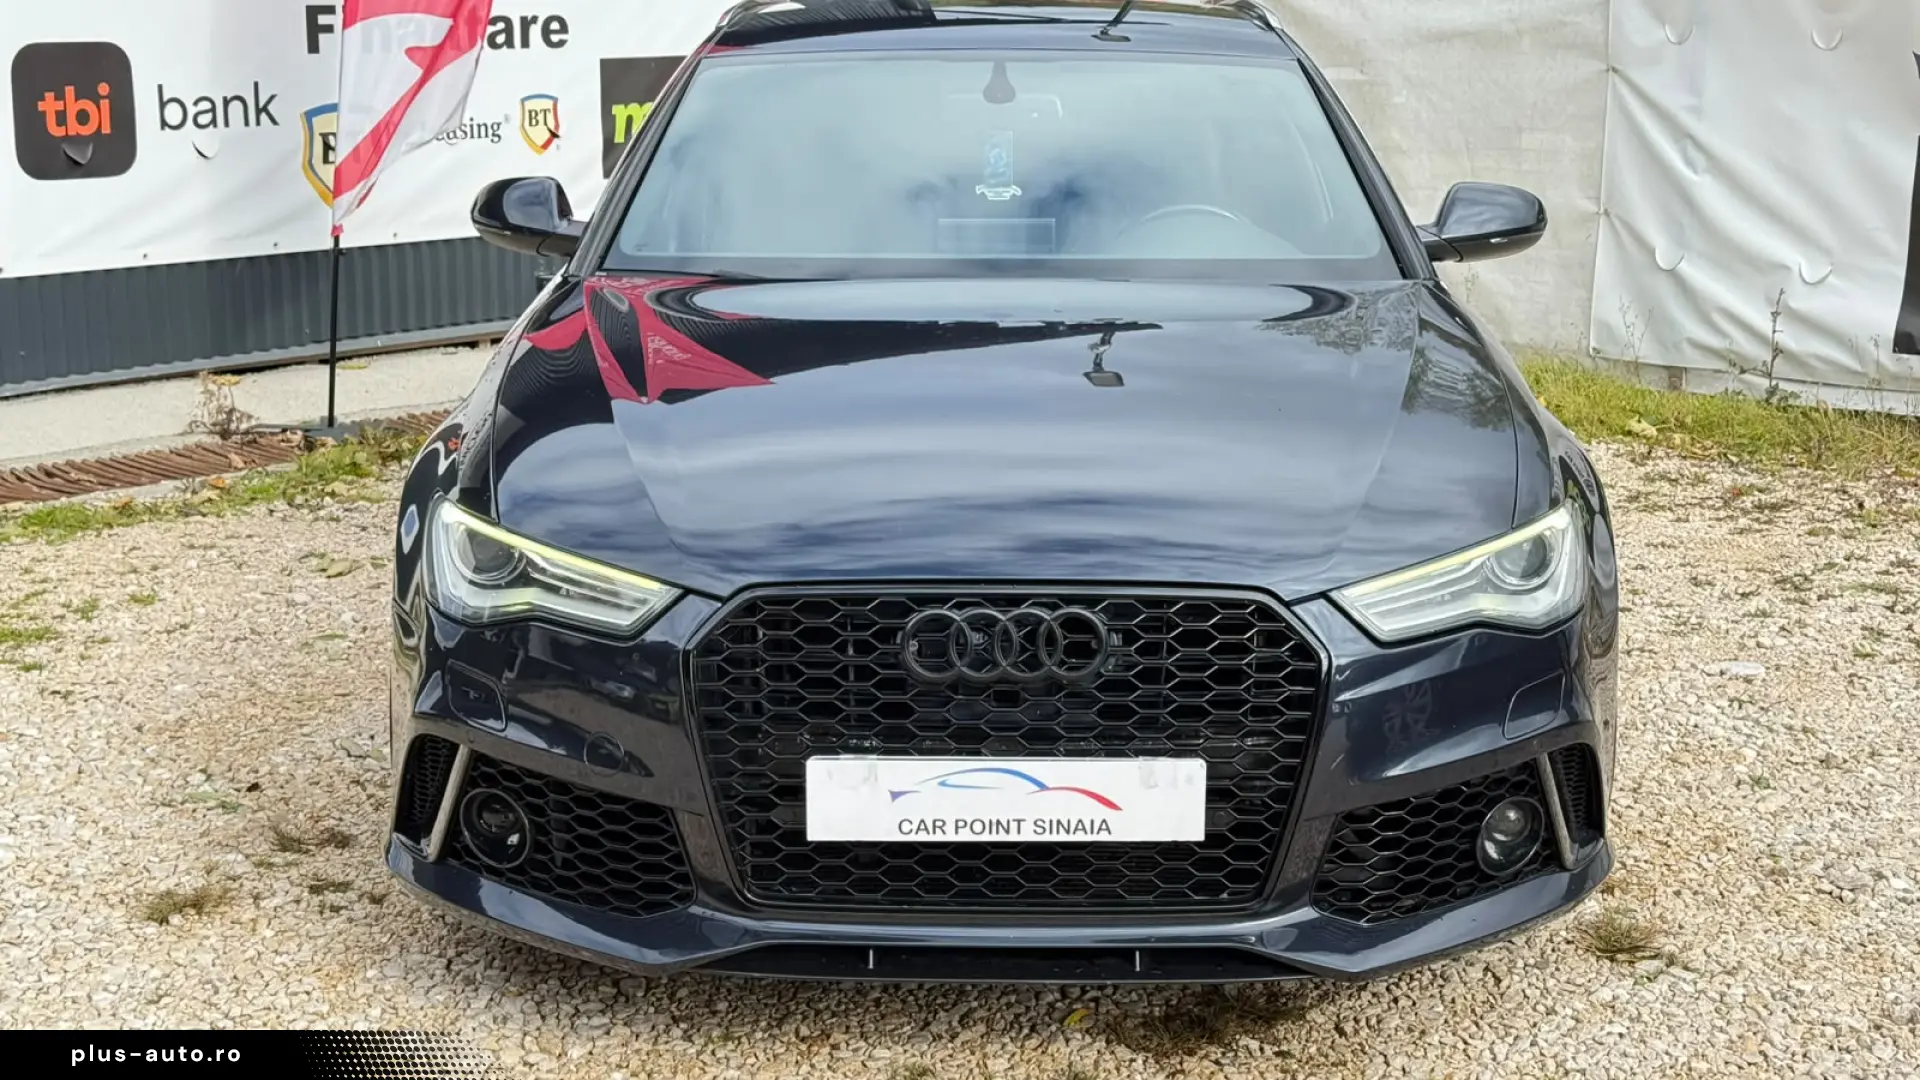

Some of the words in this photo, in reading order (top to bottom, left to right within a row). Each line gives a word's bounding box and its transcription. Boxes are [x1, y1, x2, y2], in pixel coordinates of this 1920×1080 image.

[38, 83, 111, 137] tbi
[157, 81, 280, 131] bank
[528, 108, 558, 138] BT
[899, 818, 946, 836] CAR
[954, 818, 1026, 836] POINT
[1033, 818, 1112, 836] SINAIA
